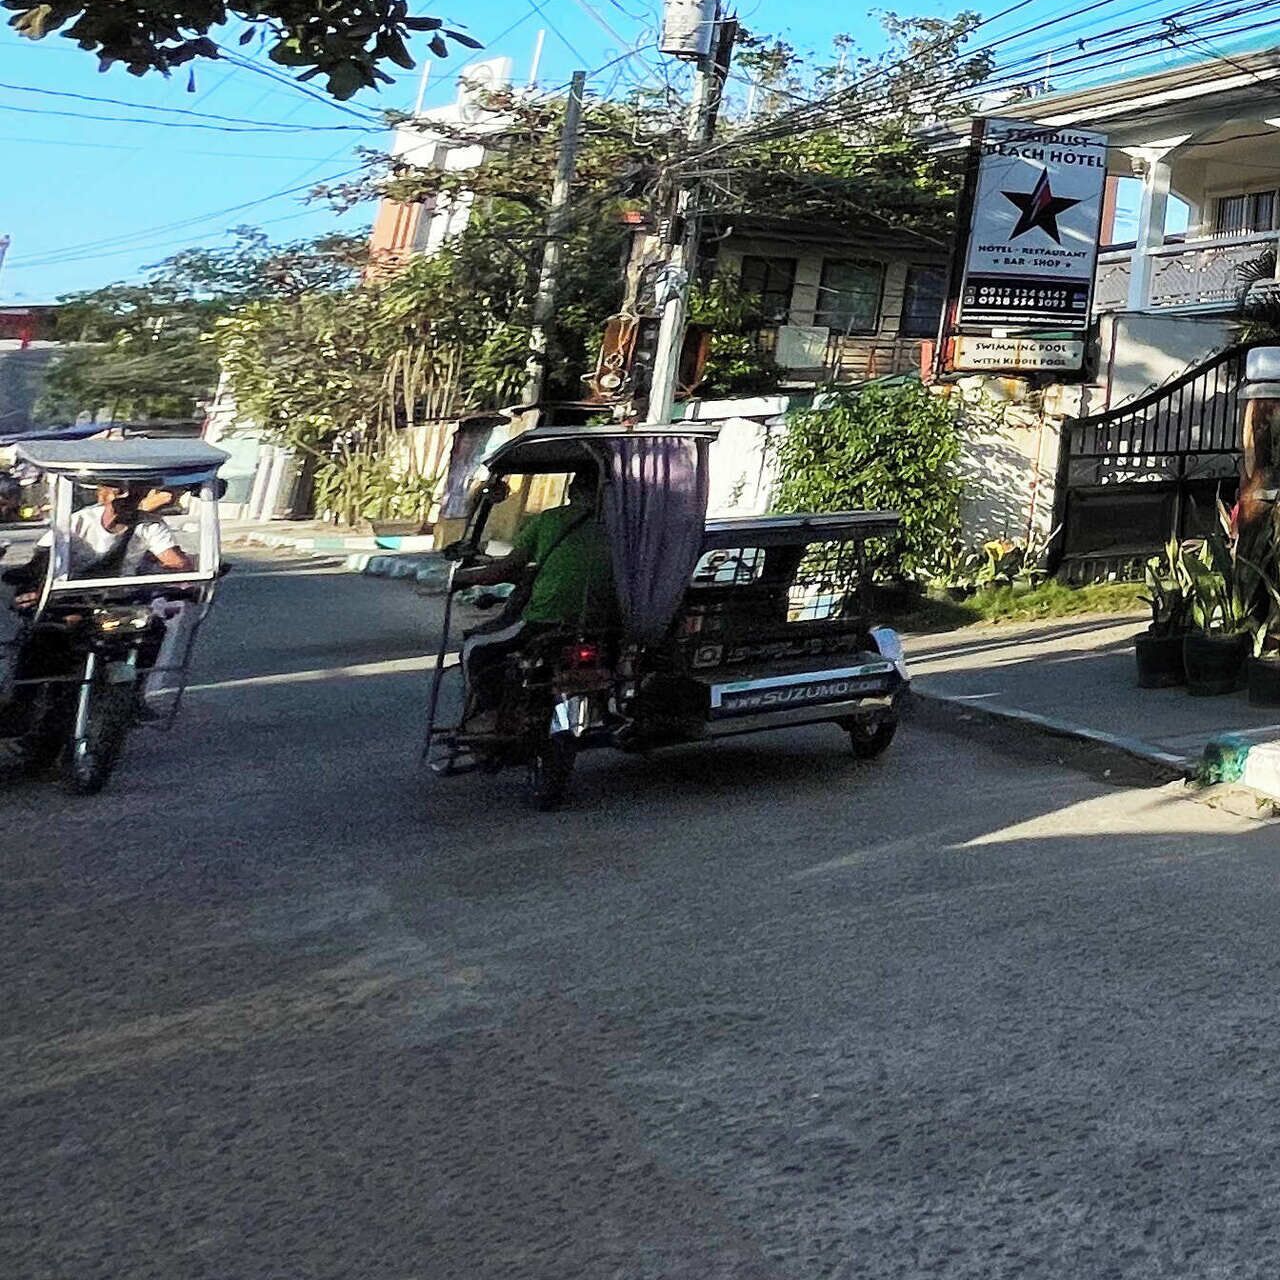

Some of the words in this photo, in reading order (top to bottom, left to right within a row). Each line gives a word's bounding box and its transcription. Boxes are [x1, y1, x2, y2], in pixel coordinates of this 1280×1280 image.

[978, 245, 1013, 254] HOTEL
[1033, 258, 1061, 267] SHOP
[976, 343, 1036, 351] SWIMMING
[1039, 344, 1067, 352] POOL
